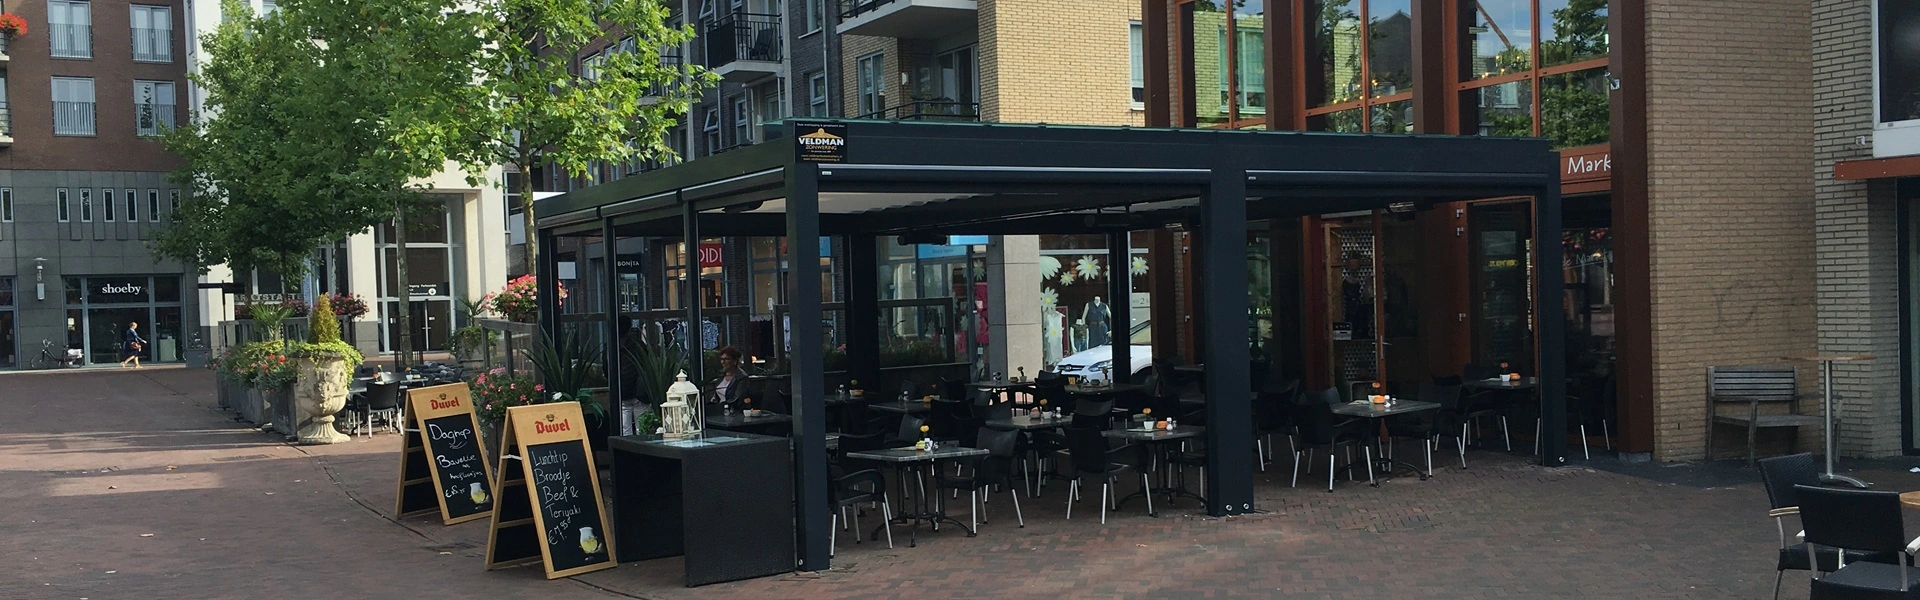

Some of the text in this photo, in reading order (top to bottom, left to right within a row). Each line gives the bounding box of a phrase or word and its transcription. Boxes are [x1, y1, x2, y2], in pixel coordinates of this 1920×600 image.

[798, 137, 844, 146] VELDMAN
[617, 260, 640, 268] BONITA
[101, 282, 142, 296] shoeby
[429, 397, 461, 410] Duvel
[534, 418, 571, 434] Duvel
[531, 450, 568, 467] Lunchtip
[533, 468, 571, 485] Broodje
[542, 485, 579, 504] Beef &
[545, 503, 581, 520] Teriyaki
